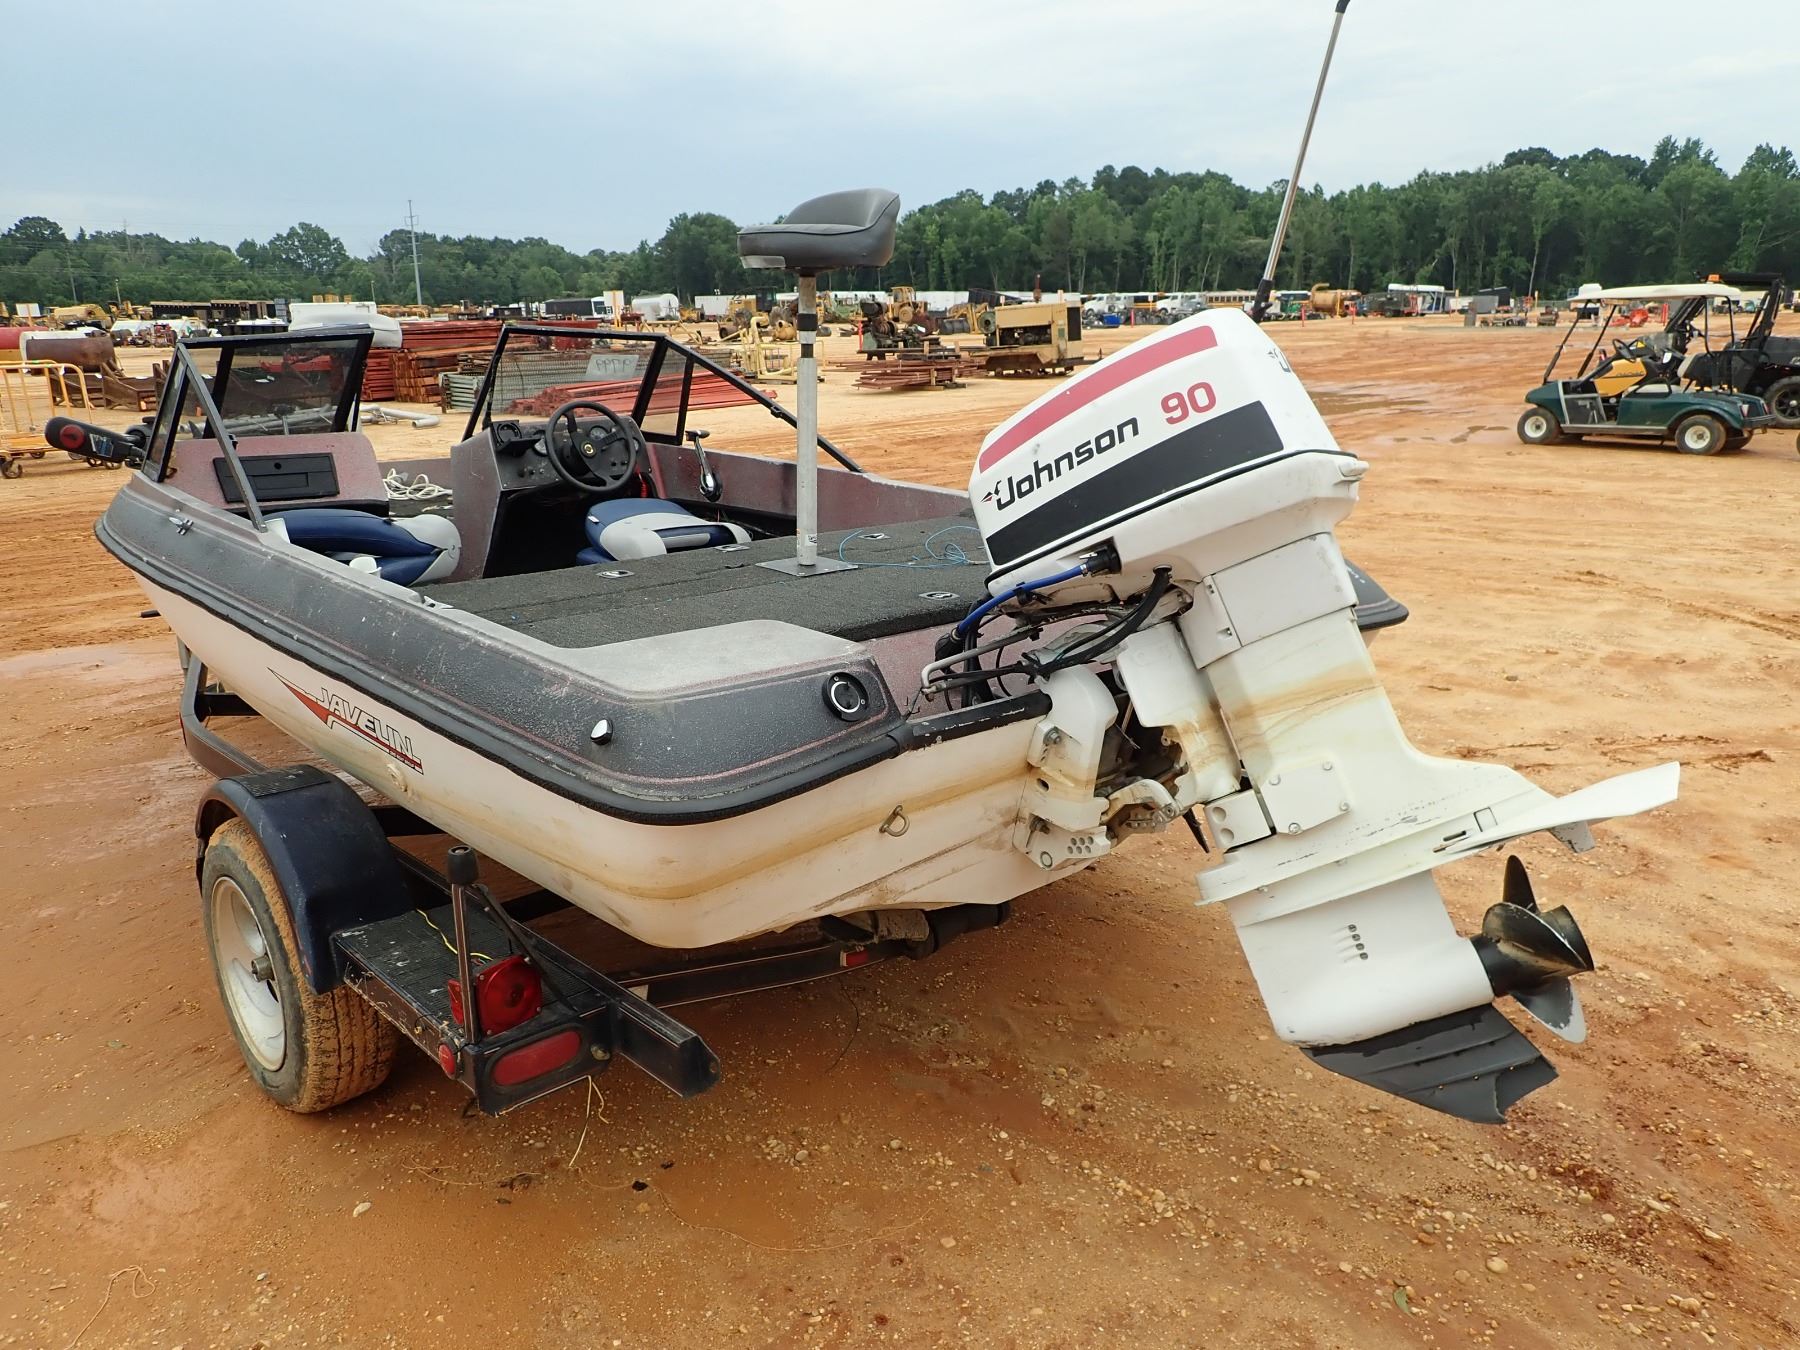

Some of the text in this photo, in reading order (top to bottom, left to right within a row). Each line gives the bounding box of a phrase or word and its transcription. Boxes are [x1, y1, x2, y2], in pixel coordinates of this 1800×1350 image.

[997, 381, 1217, 511] Johnson 90
[317, 687, 415, 758] JAVELIN
